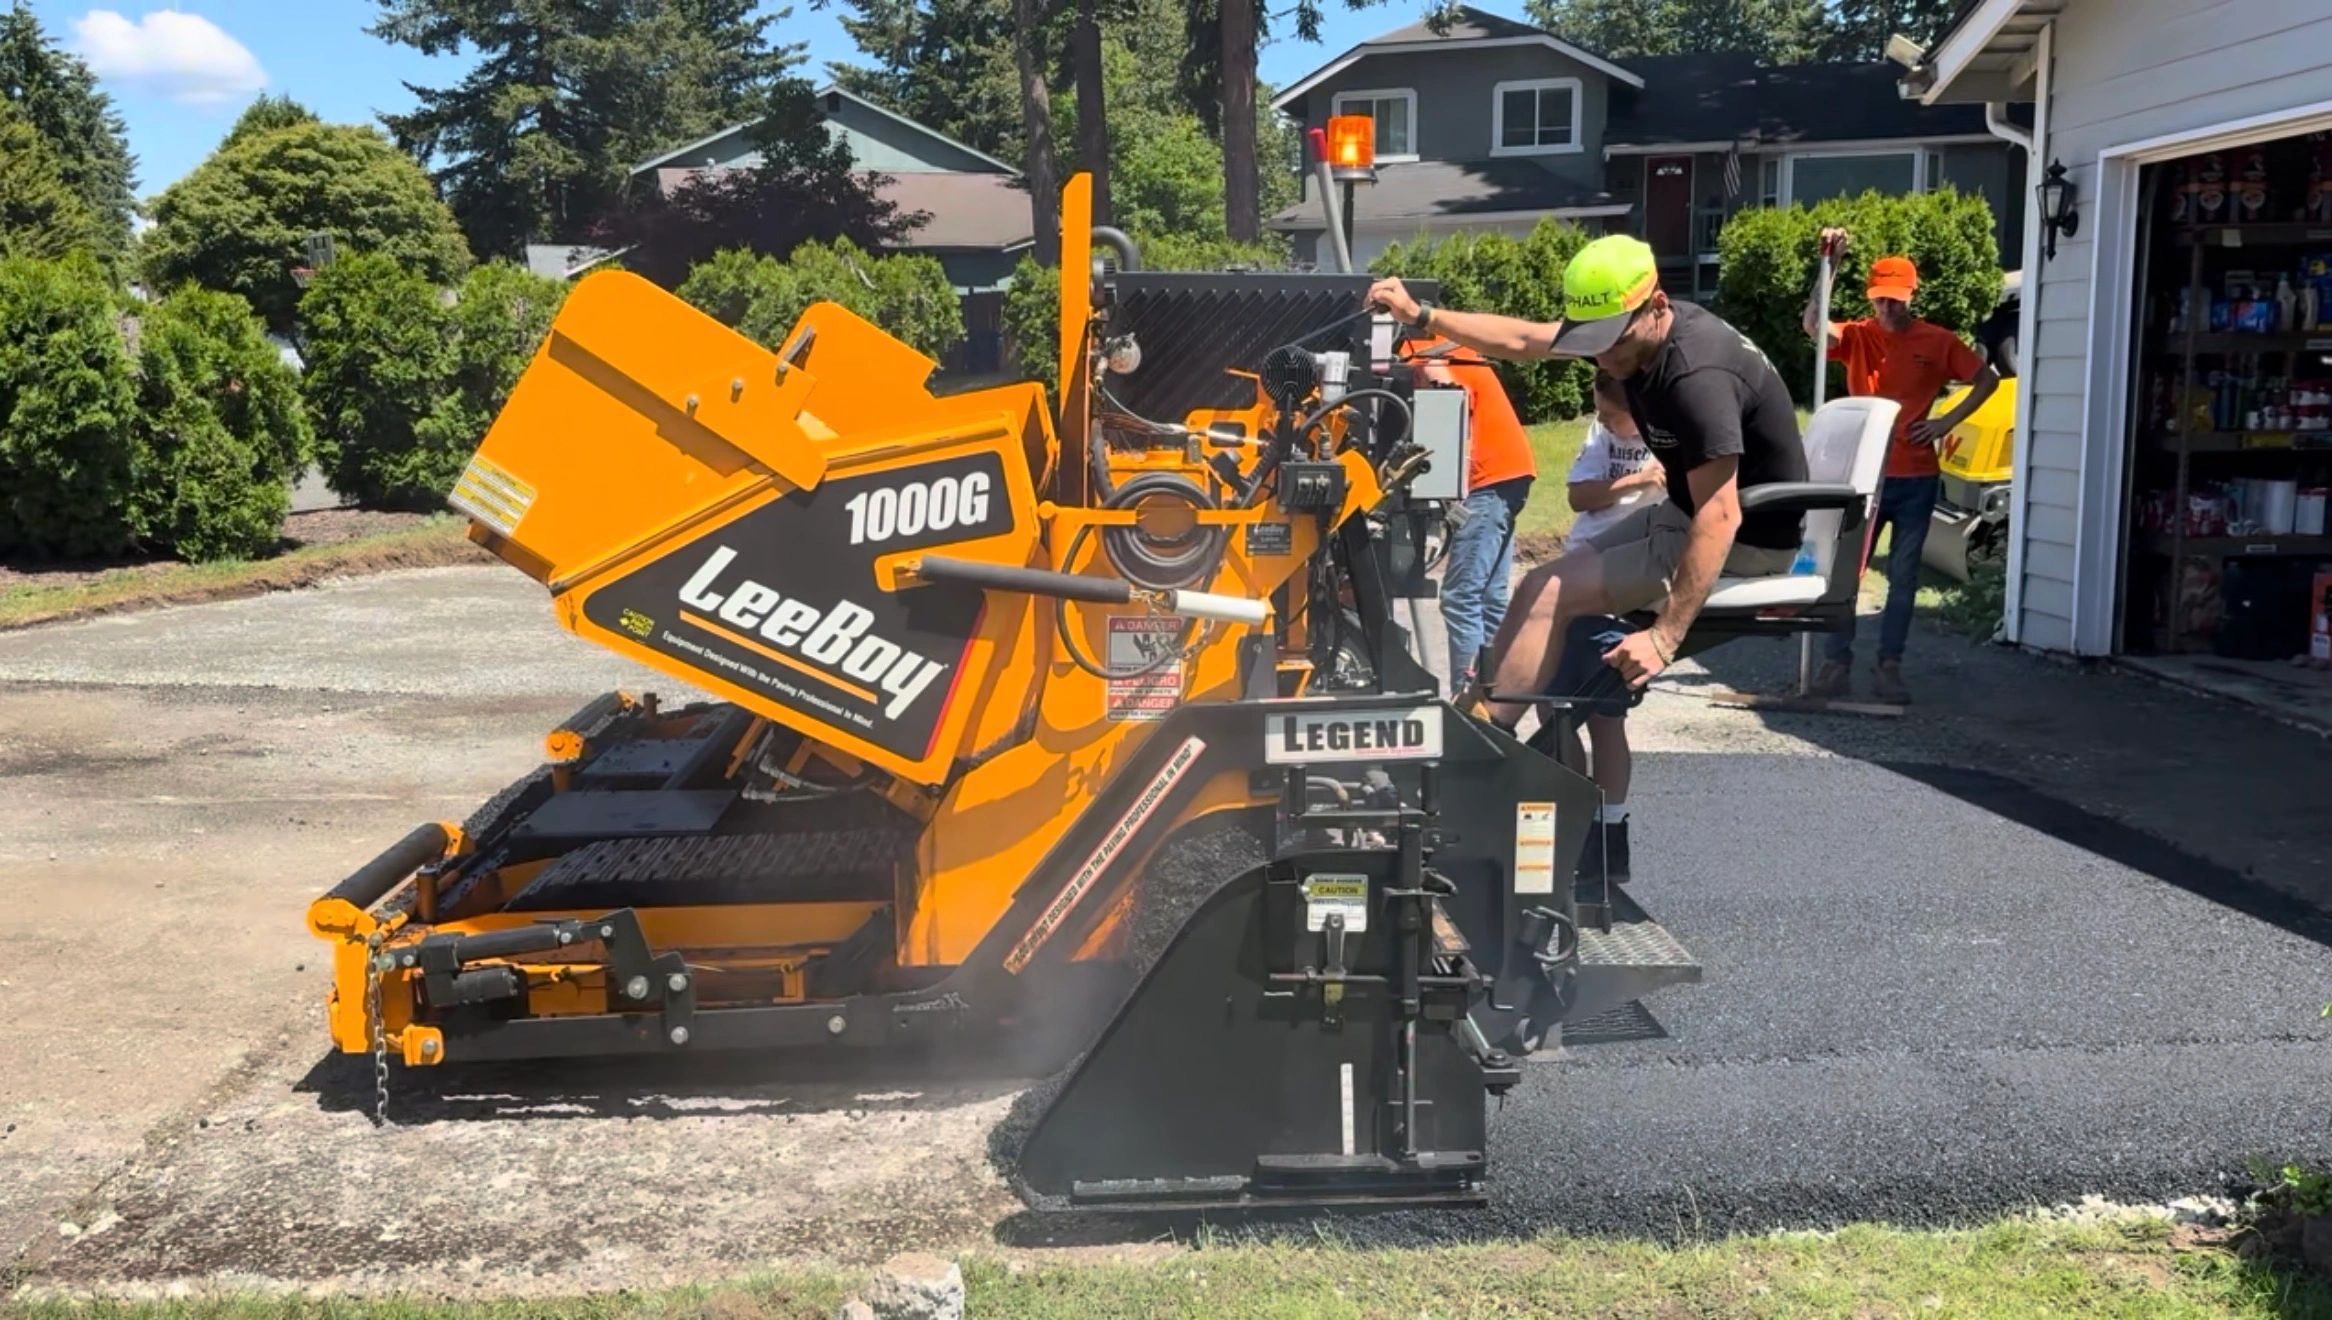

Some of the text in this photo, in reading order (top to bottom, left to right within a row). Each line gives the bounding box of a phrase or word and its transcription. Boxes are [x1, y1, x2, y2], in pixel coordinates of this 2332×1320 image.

[845, 471, 990, 545] 1000G
[678, 544, 944, 720] LeeBoy
[1127, 620, 1178, 631] DANER
[660, 629, 704, 656] Equipment
[701, 647, 740, 672] Designed
[769, 676, 798, 697] Paving
[796, 688, 844, 716] Professional
[1284, 716, 1424, 752] LEGEND
[1045, 885, 1078, 924] DESIGNED
[1074, 866, 1094, 889] WITH
[1089, 851, 1106, 870] THE
[1100, 826, 1126, 857] PAVING
[1121, 776, 1168, 831] PROFESSIONAL
[1317, 886, 1359, 896] CAUTION
